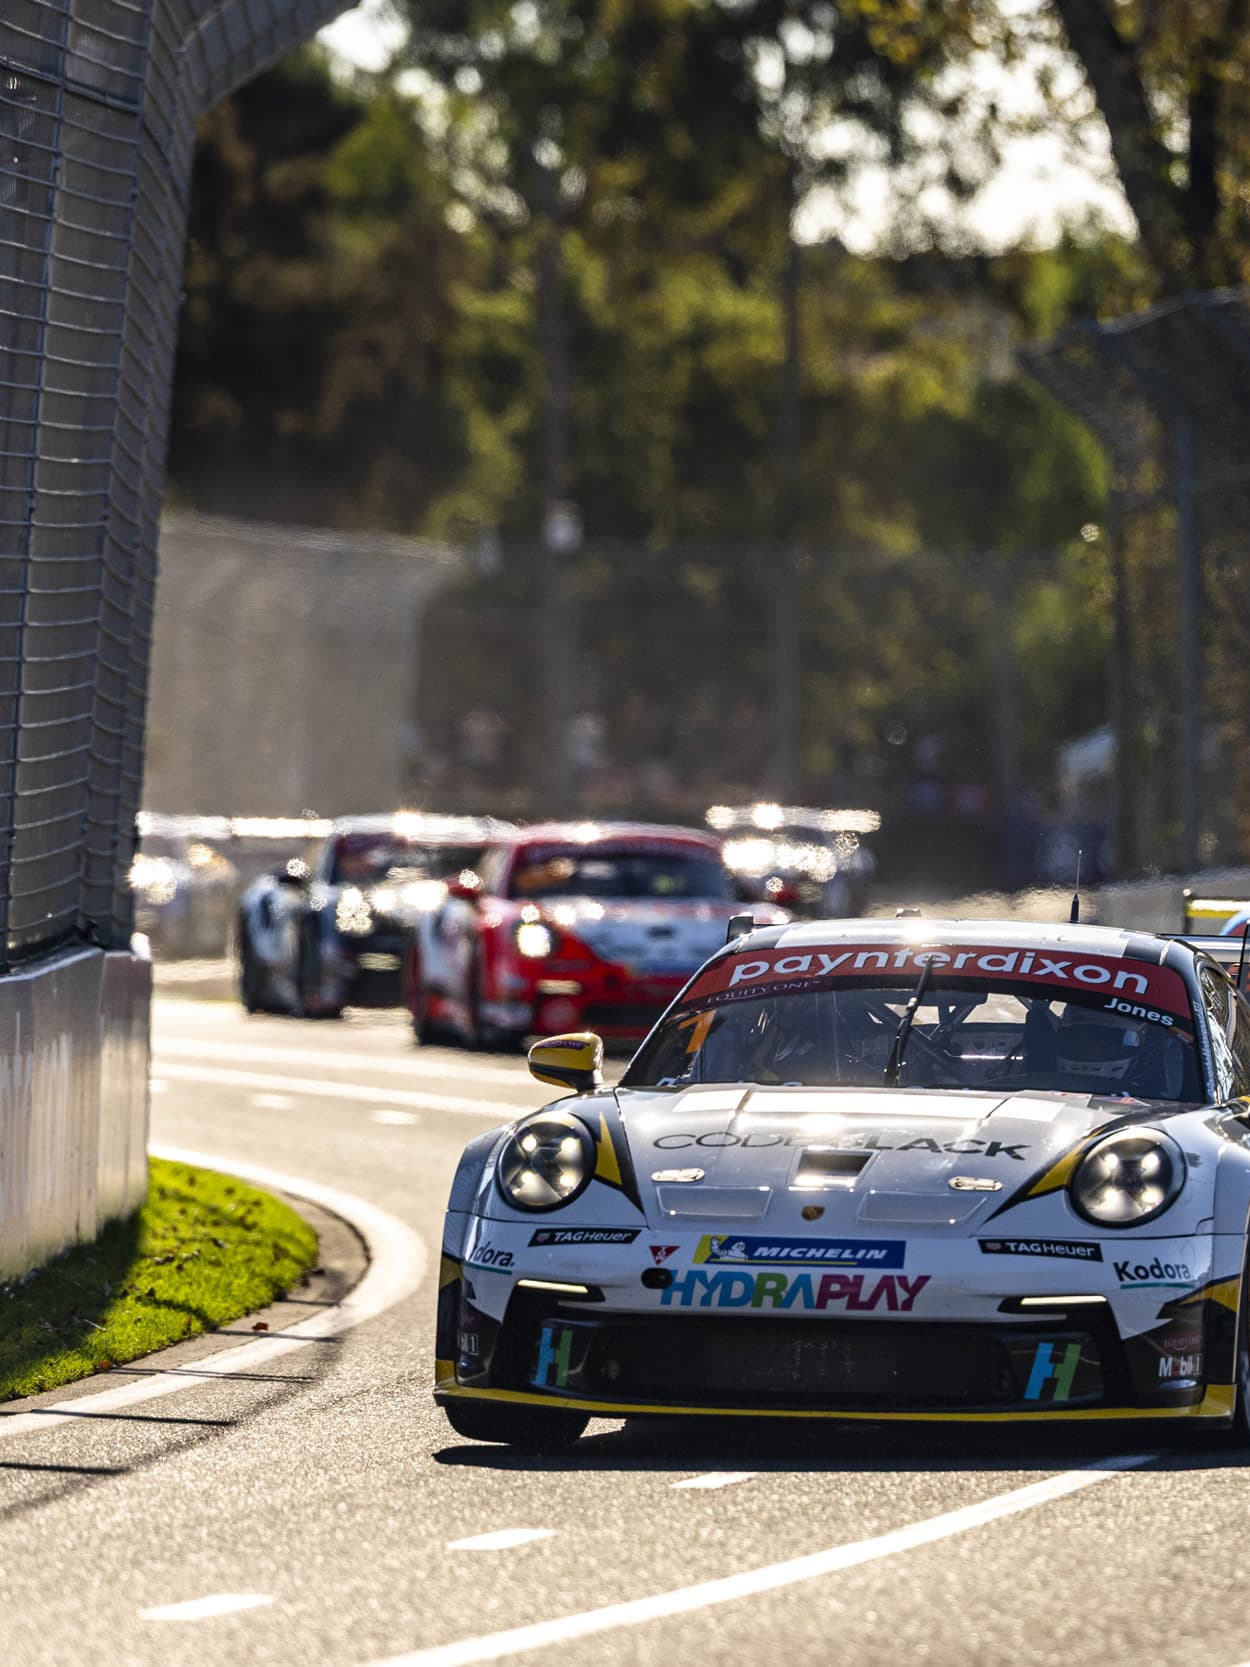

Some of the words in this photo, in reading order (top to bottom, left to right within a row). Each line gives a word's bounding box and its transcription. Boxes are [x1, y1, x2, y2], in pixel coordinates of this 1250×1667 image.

[728, 947, 1149, 994] paynterdixon
[1104, 997, 1175, 1027] Jones
[652, 1131, 1033, 1161] CODELACK
[753, 1246, 888, 1260] MICHELIN
[659, 1269, 932, 1312] HYDRAPLAY
